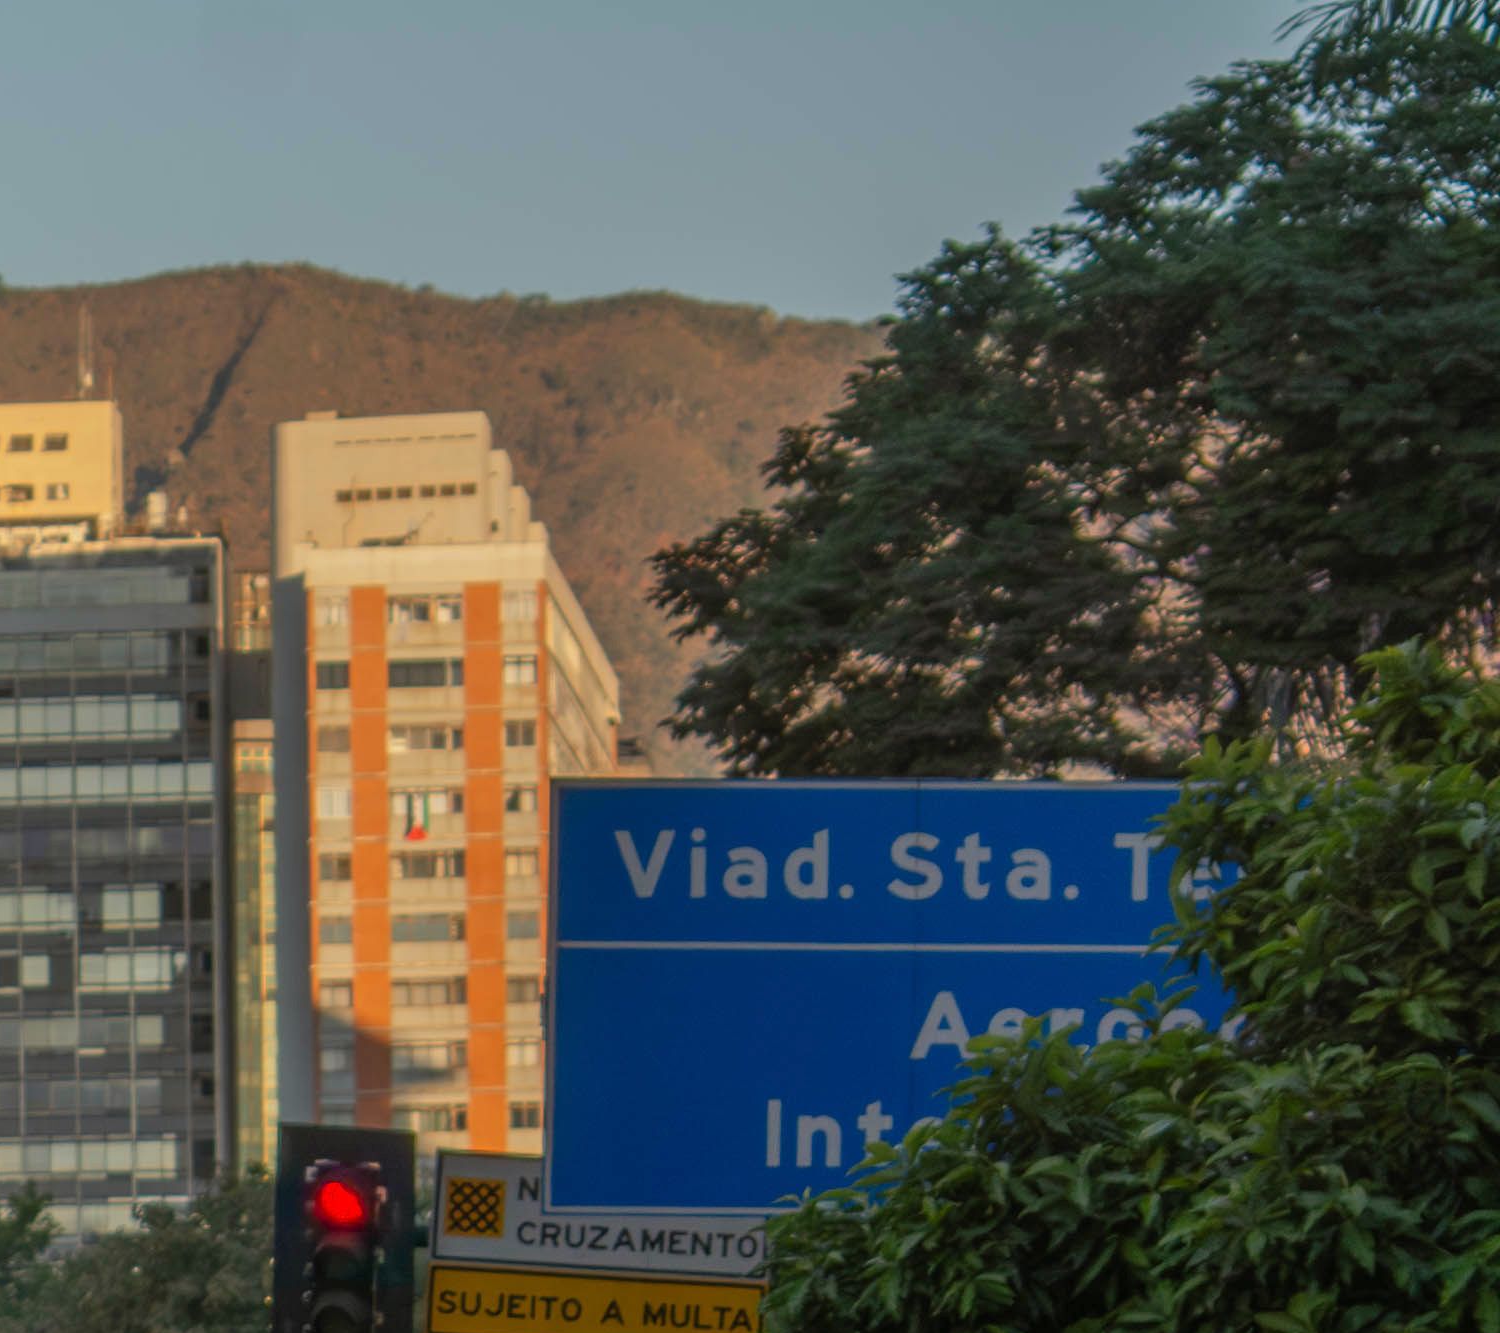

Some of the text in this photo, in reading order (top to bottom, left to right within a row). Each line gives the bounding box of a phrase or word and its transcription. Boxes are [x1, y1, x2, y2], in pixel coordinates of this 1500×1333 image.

[615, 827, 855, 900] Viad.
[887, 832, 1080, 901] Sta.
[517, 1221, 757, 1259] CRUZAMENTO
[436, 1289, 751, 1332] SUJEITO A MULTA
